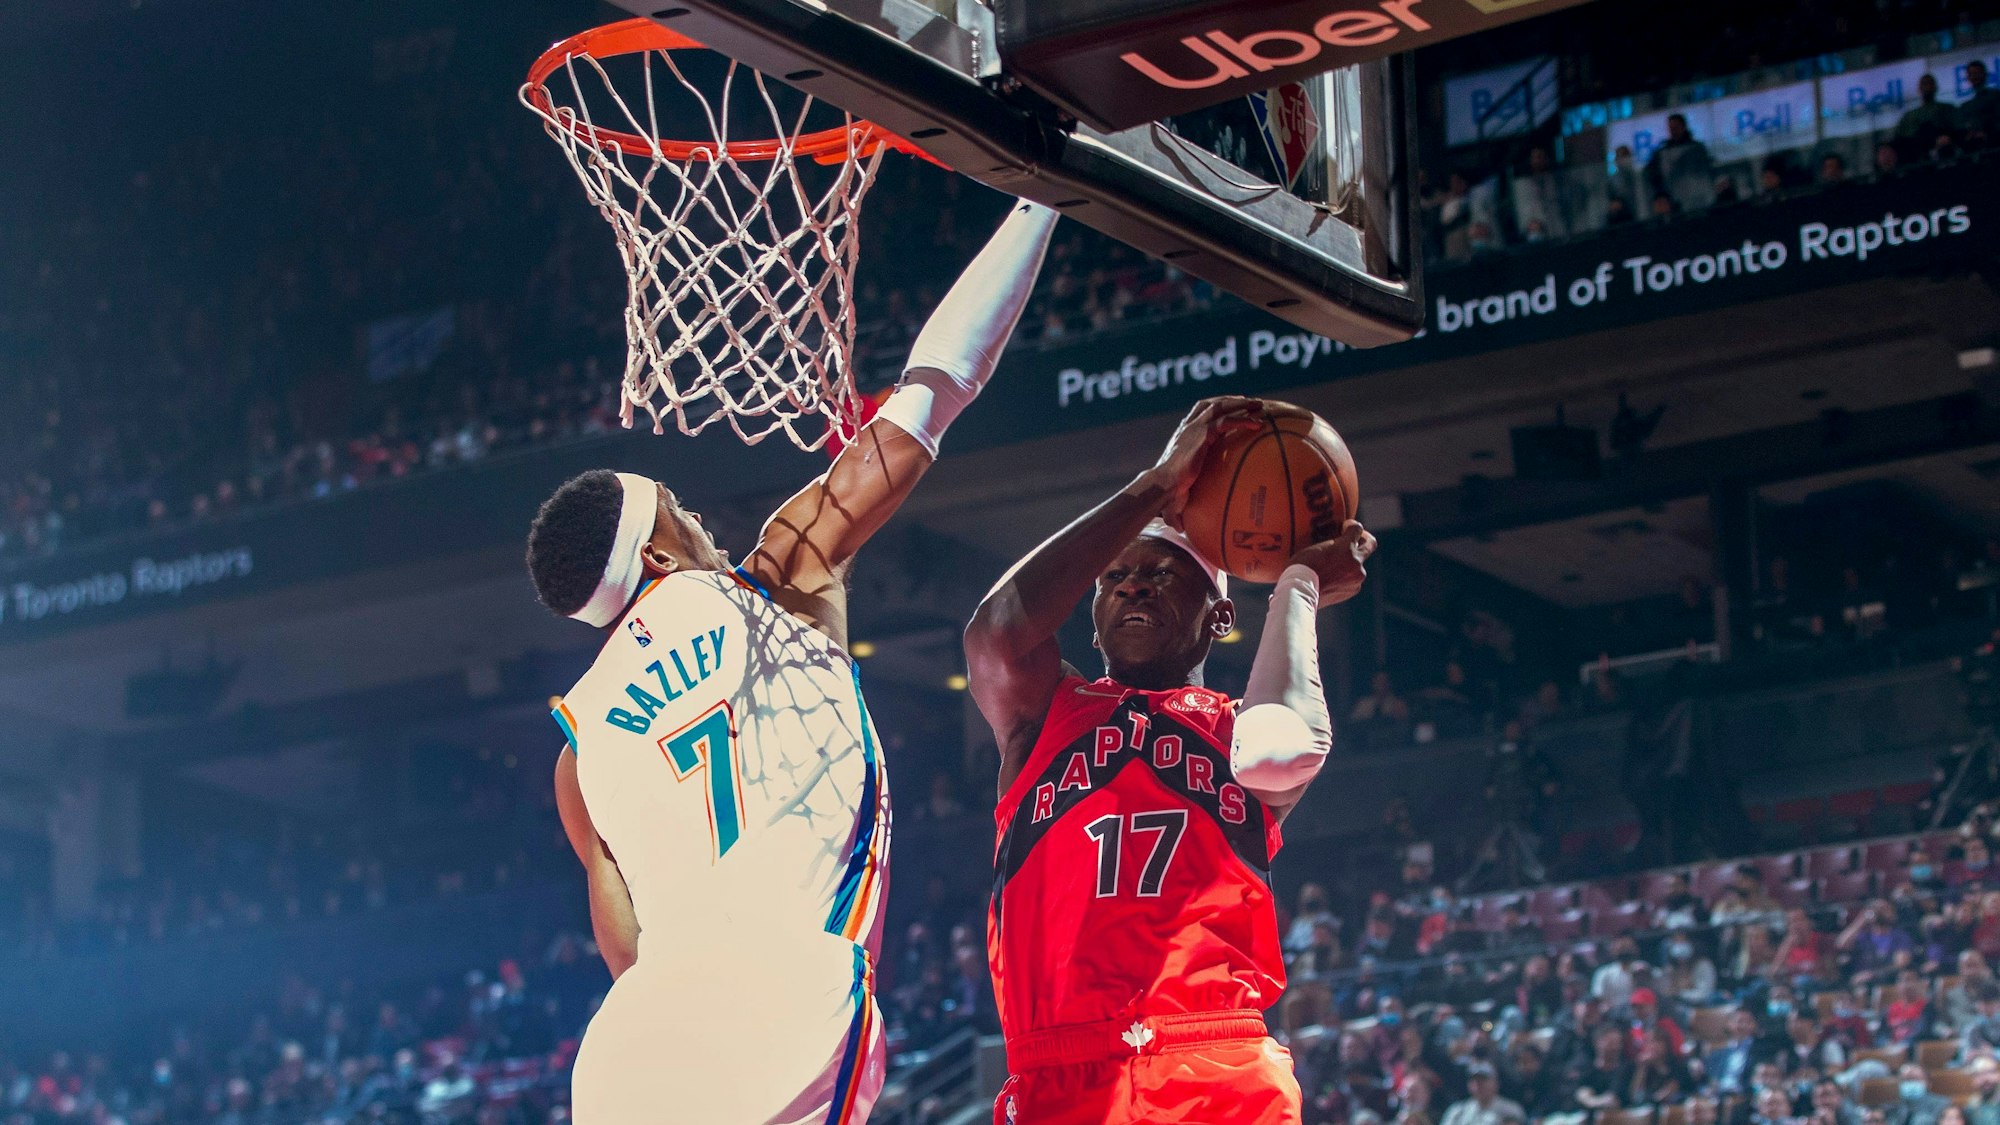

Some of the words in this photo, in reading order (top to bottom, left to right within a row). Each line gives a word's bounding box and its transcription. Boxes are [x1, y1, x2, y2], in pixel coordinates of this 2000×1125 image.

[1120, 0, 1431, 89] Uber
[1736, 102, 1791, 136] Bell
[1848, 79, 1903, 113] Bell
[1058, 336, 1237, 406] Preferred
[1437, 275, 1556, 332] brand
[1568, 262, 1613, 306] of
[1624, 240, 1787, 295] Toronto
[1801, 205, 1971, 260] Raptors
[605, 625, 725, 735] BAZLEY
[1169, 700, 1194, 712] Sun
[657, 699, 746, 867] 7
[1031, 711, 1246, 824] RAPTORS
[1084, 809, 1188, 898] 17
